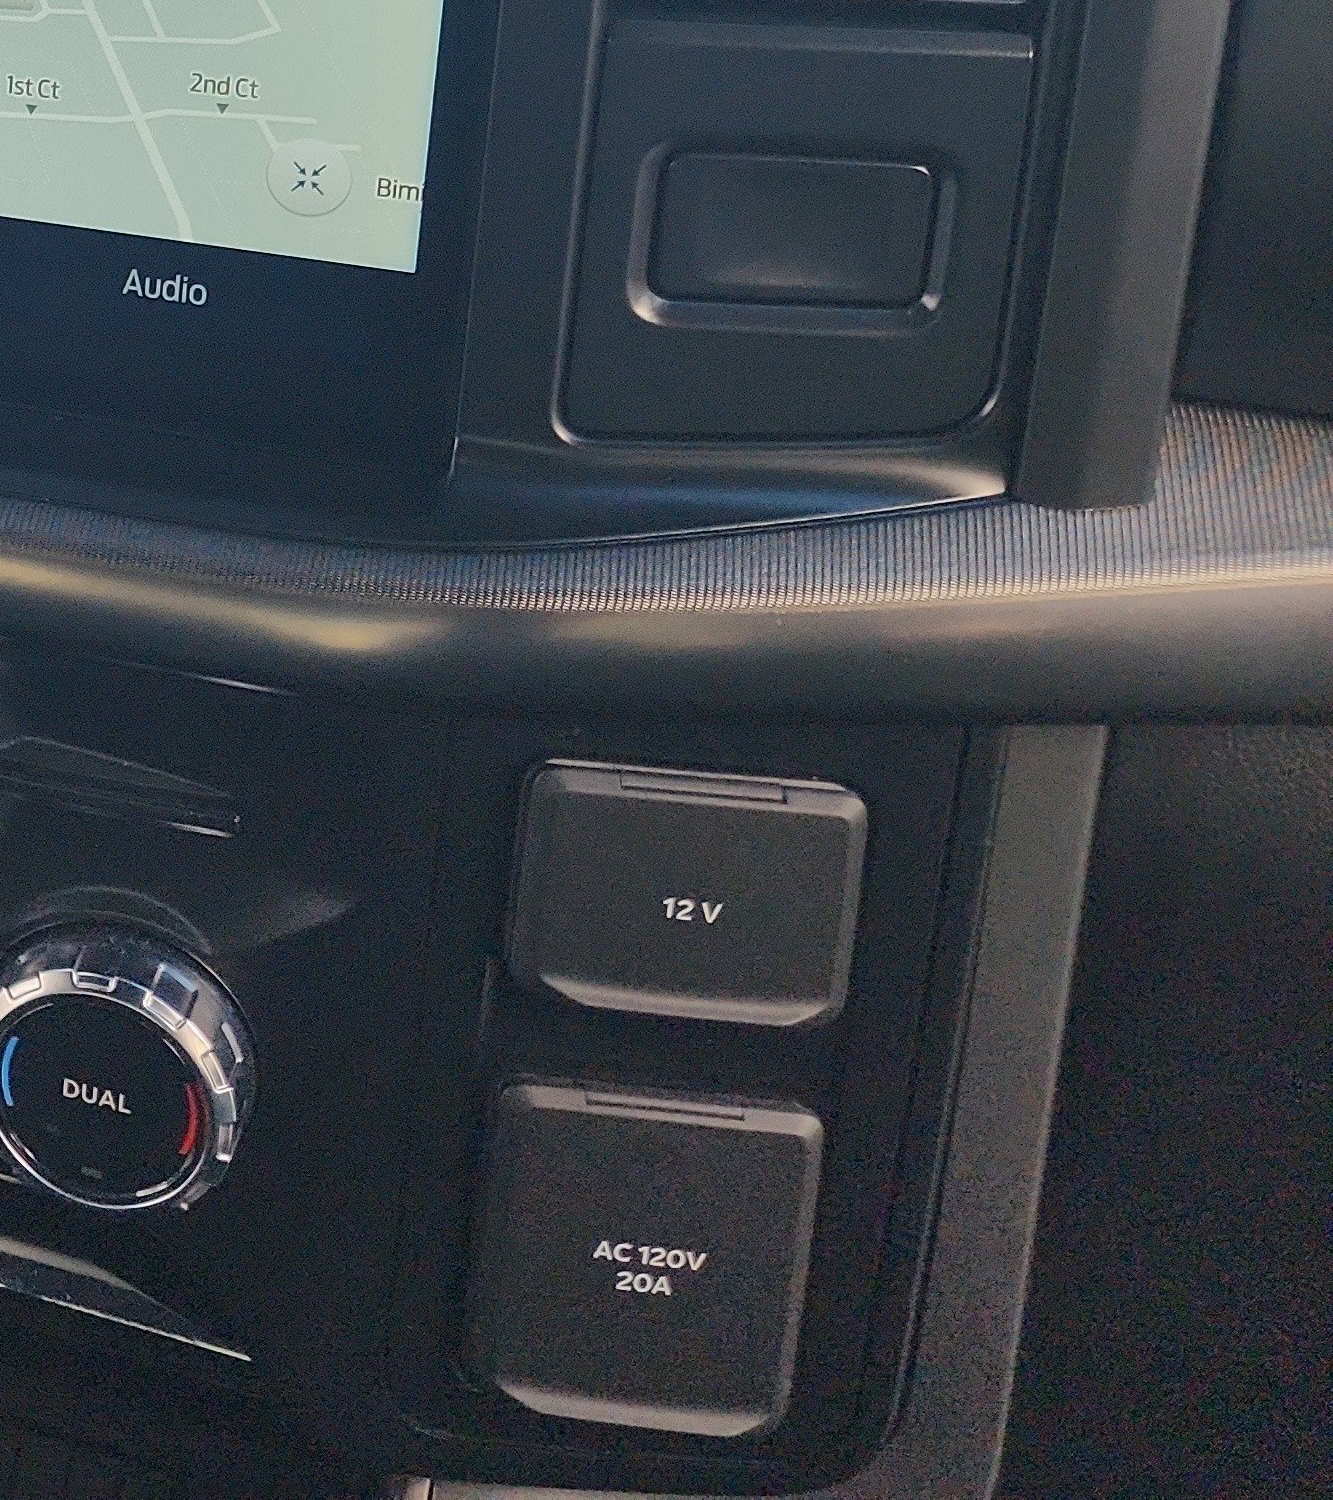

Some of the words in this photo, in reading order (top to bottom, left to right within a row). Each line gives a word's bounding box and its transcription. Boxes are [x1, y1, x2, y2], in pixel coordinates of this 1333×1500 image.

[6, 75, 33, 98] 1st
[36, 77, 61, 100] Ct
[188, 72, 230, 97] 2nd
[234, 77, 259, 100] Ct
[376, 177, 424, 202] Bim
[121, 267, 208, 307] Audio
[662, 896, 694, 922] 12
[700, 901, 723, 925] V
[63, 1077, 131, 1114] DUAL
[593, 1239, 632, 1264] AC
[637, 1244, 707, 1272] 120V
[615, 1270, 673, 1297] 20A
